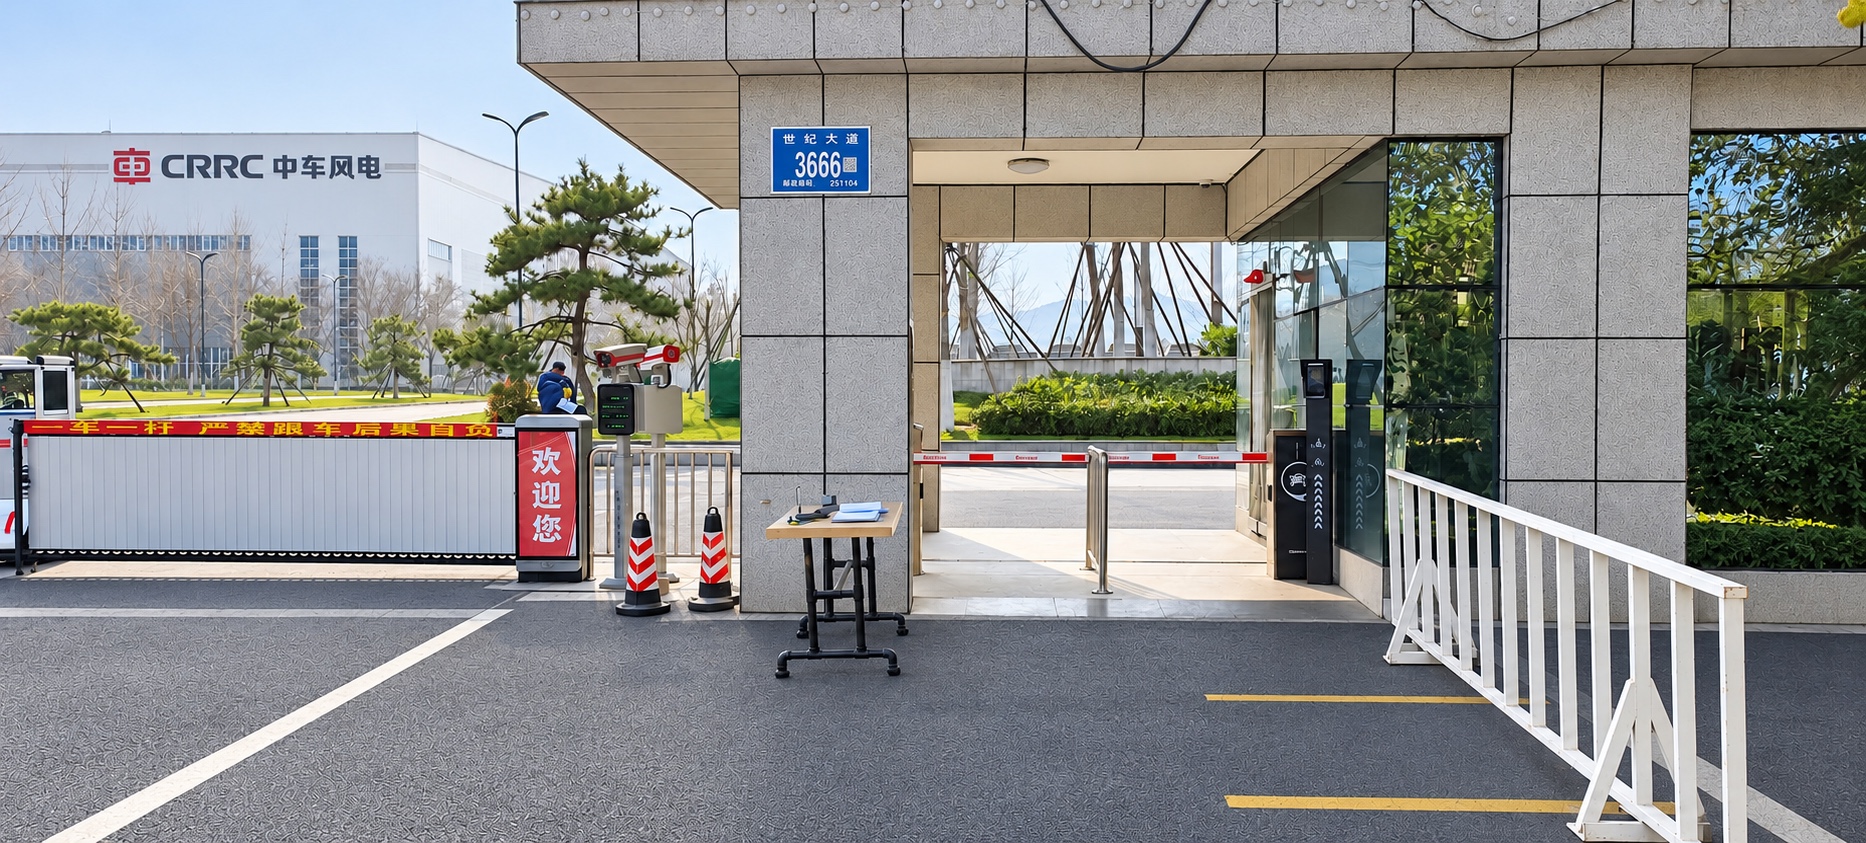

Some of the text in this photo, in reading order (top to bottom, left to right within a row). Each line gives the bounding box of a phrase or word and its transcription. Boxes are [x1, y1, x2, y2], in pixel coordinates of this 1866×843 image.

[782, 133, 859, 145] 世纪大道
[161, 154, 382, 180] CRRC 中车风电
[794, 151, 841, 178] 3666
[829, 179, 859, 188] 251104
[31, 420, 493, 437] 一车一杆 严禁跟车后果自负
[531, 446, 562, 544] 欢迎您
